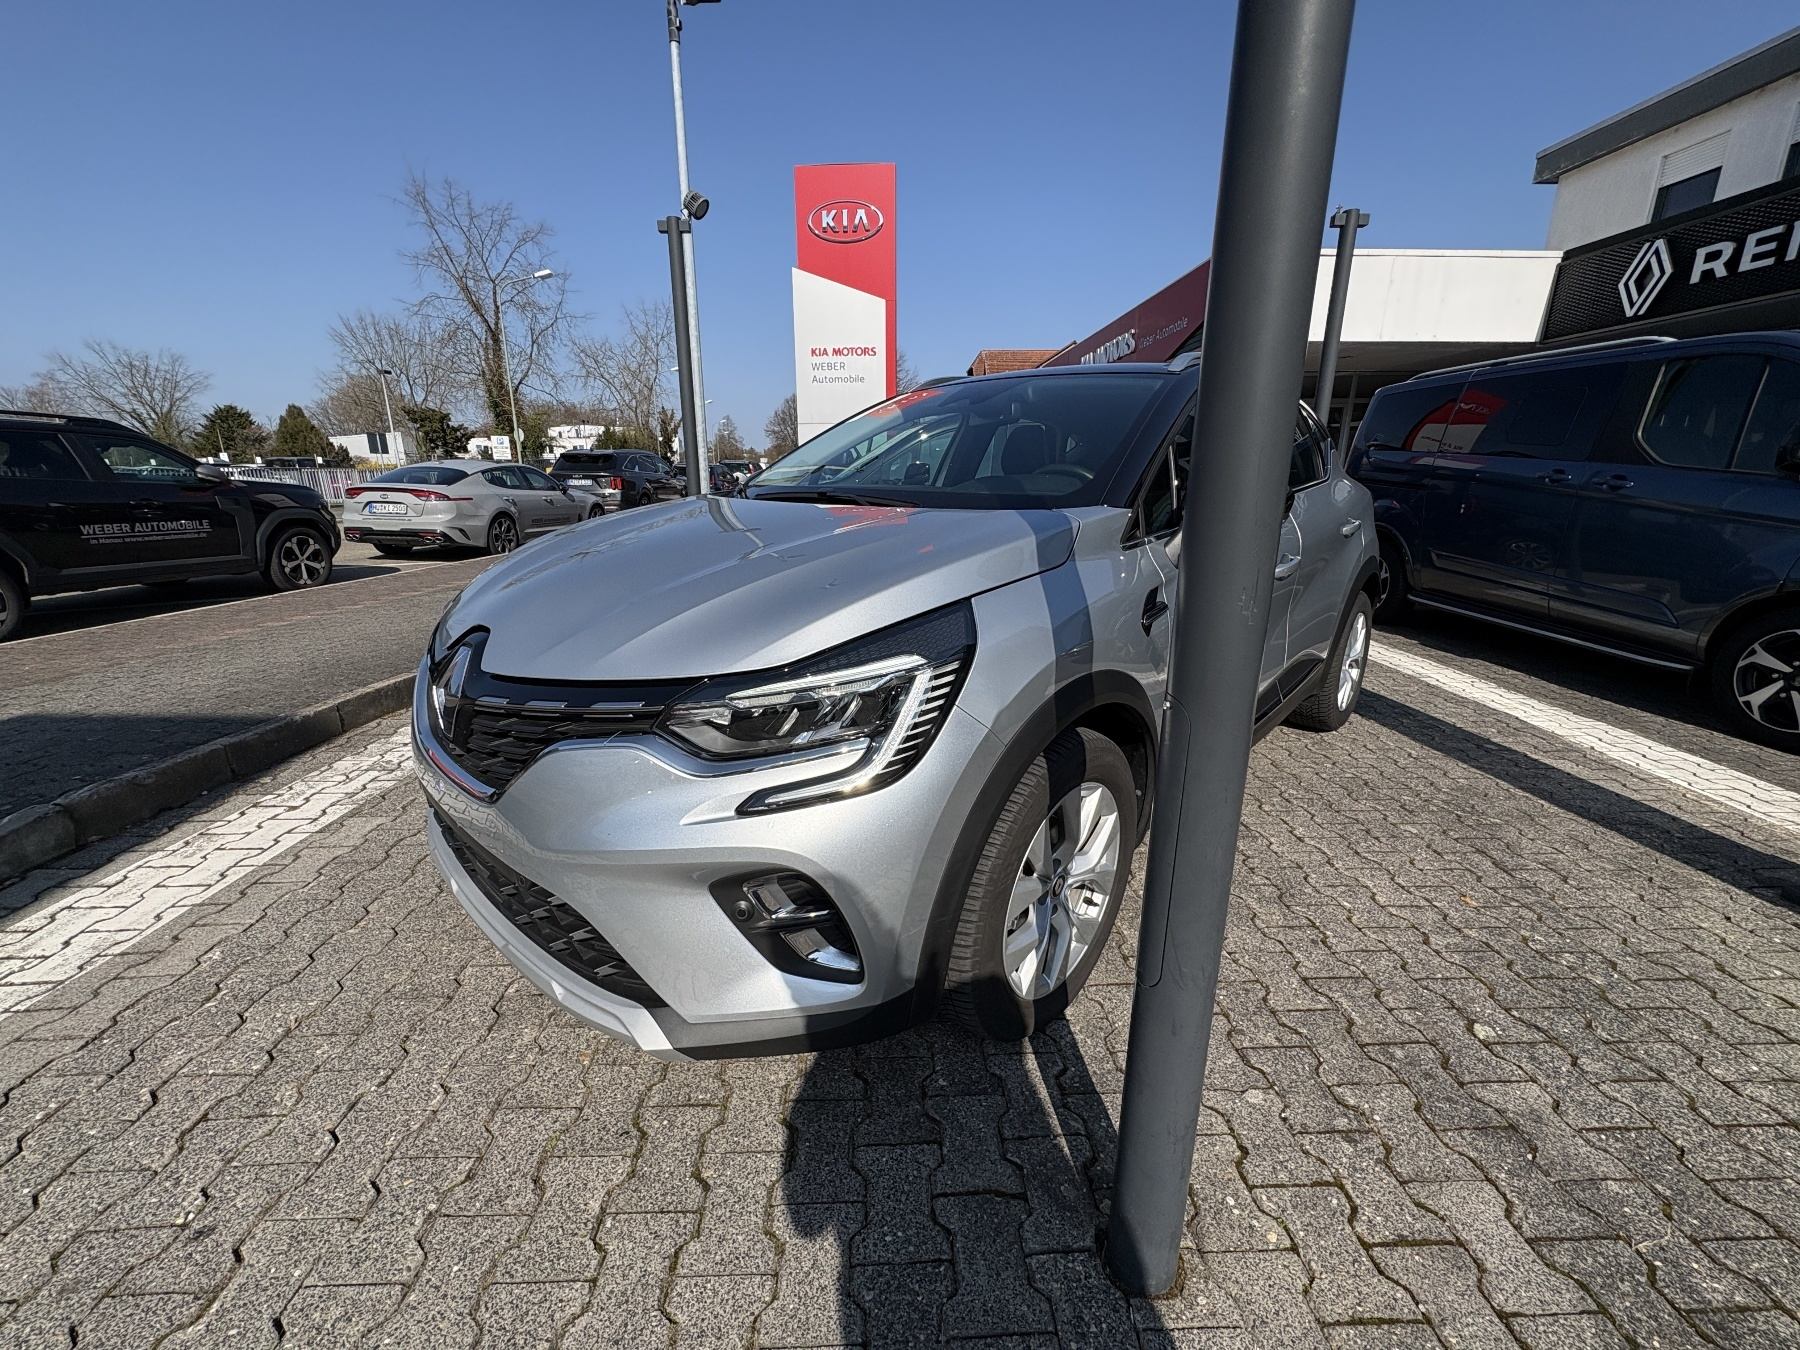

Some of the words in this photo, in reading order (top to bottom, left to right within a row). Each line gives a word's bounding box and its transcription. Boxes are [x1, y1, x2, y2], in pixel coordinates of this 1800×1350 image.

[821, 208, 871, 232] KIA
[811, 347, 829, 357] KIA
[832, 346, 877, 357] MOTORS
[1095, 328, 1135, 364] MOTORS
[811, 361, 846, 371] WEBER
[811, 374, 865, 384] Automobile
[80, 523, 131, 534] WEBER
[134, 520, 210, 532] AUTOMOBILE
